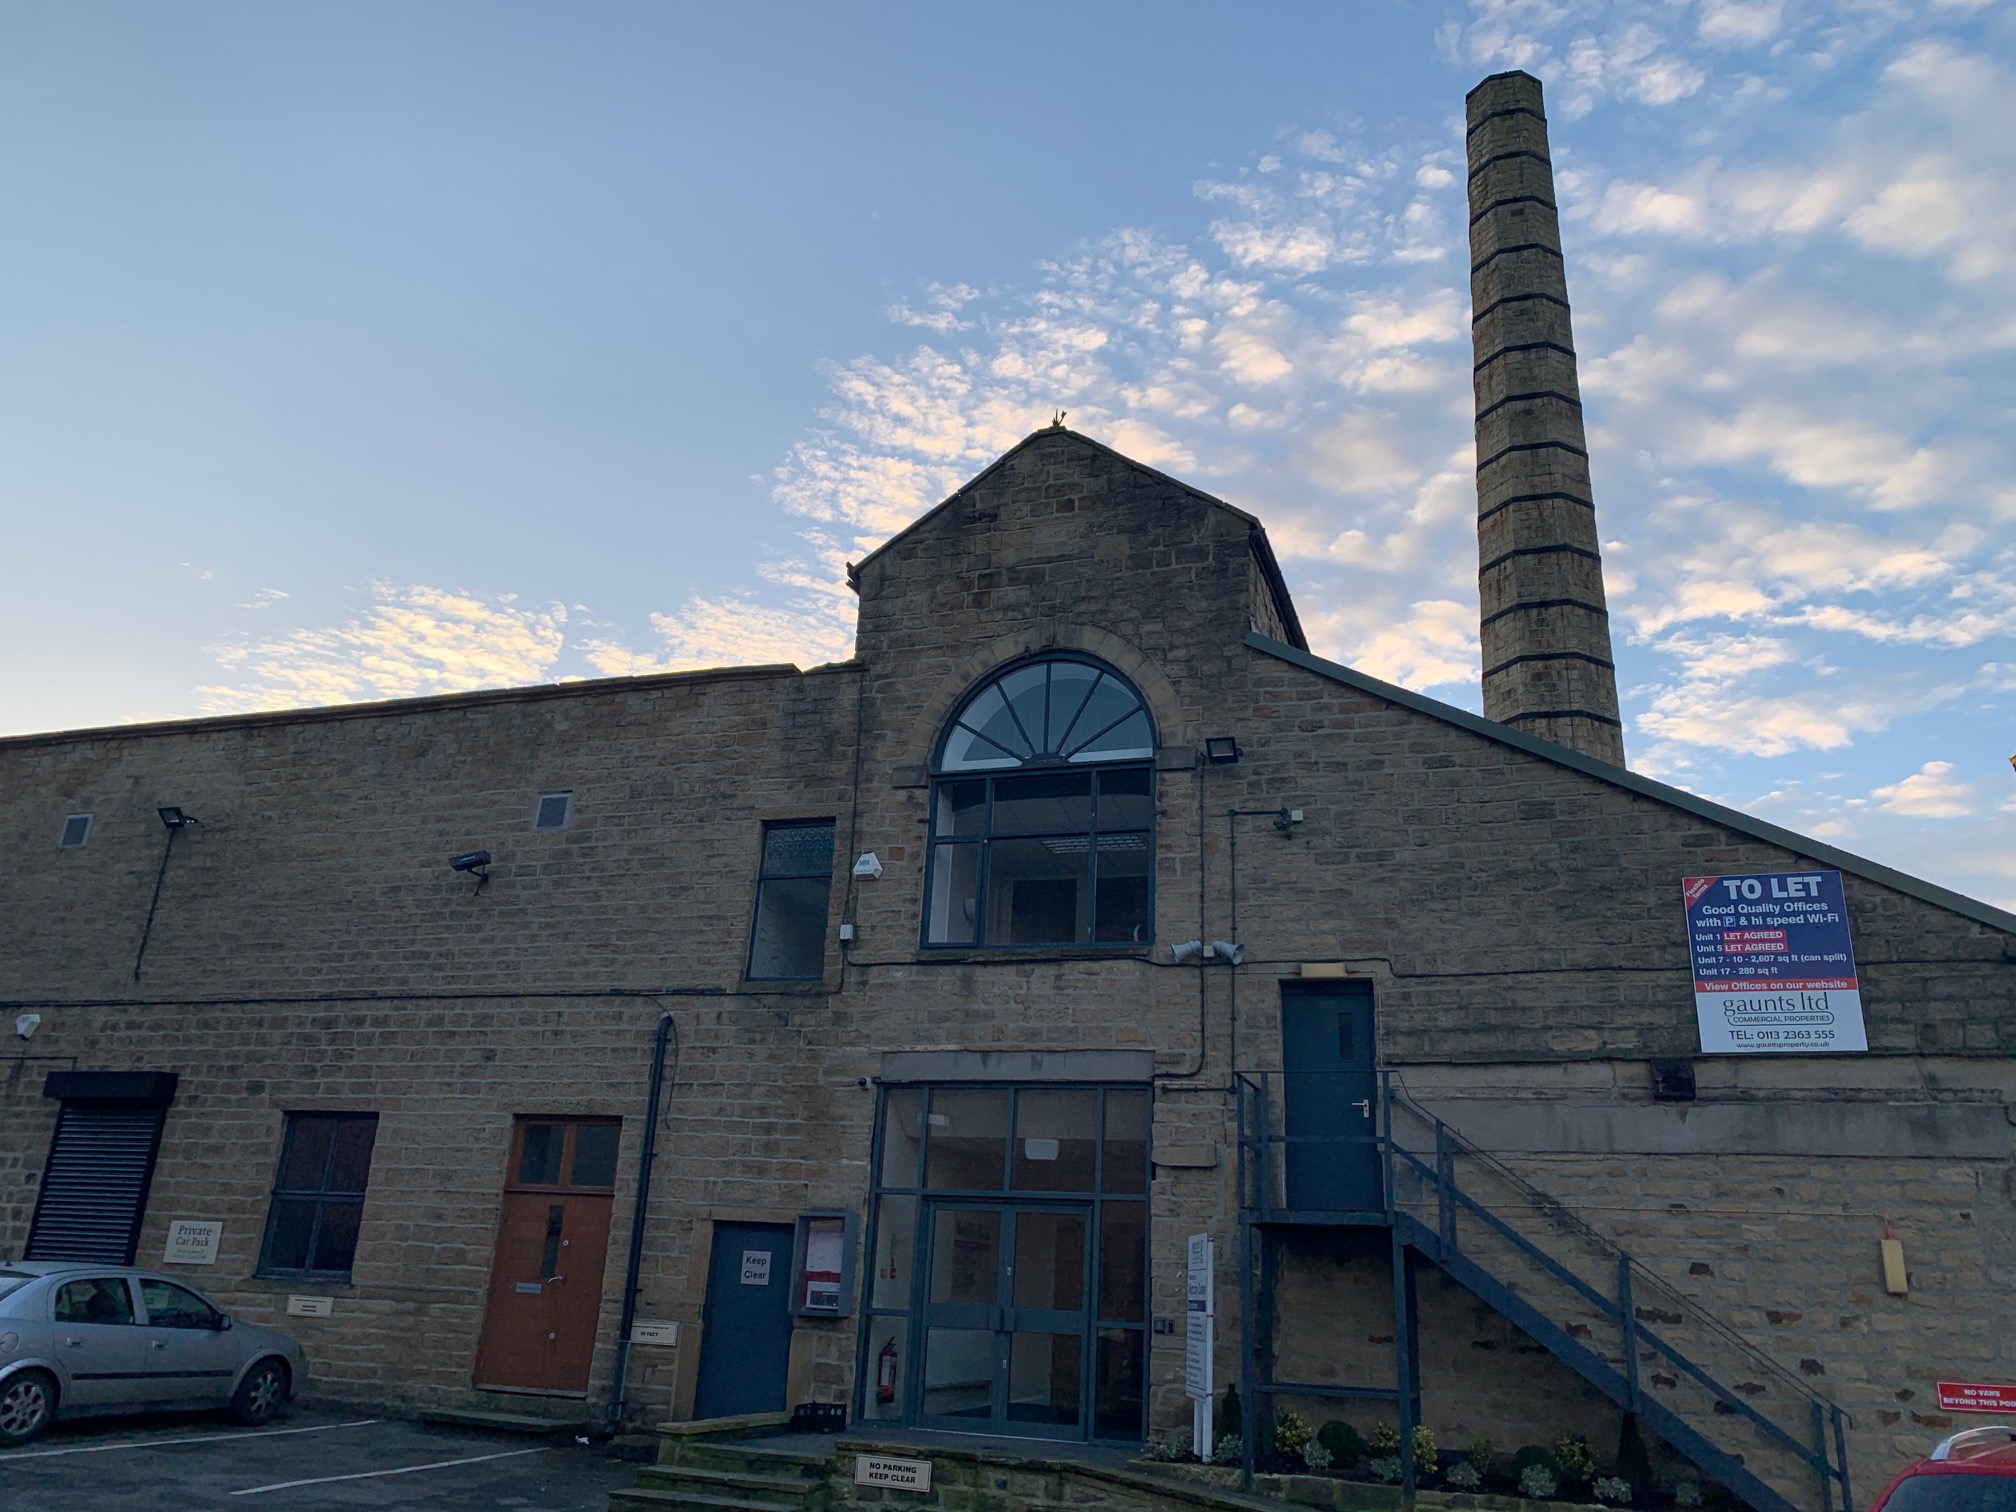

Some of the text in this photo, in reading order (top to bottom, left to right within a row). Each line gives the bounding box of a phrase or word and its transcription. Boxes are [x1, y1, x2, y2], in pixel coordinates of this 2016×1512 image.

[1685, 878, 1705, 898] Flexible
[1692, 884, 1708, 899] Terms
[1723, 876, 1822, 900] TO LET
[1702, 902, 1829, 915] Good Quality Offices
[1696, 918, 1722, 927] with
[1739, 917, 1748, 926] &
[1751, 916, 1763, 925] hi
[1766, 914, 1805, 927] speed
[1807, 913, 1839, 924] Wi-Fi
[1695, 933, 1714, 941] Unit
[1724, 932, 1741, 940] LET
[1743, 931, 1783, 939] AGREED
[1697, 945, 1716, 953] Unit
[1725, 944, 1742, 952] LET
[1745, 943, 1784, 951] AGREED
[1698, 956, 1717, 964] Unit
[1718, 956, 1723, 964] 7
[1733, 955, 1743, 963] 10
[1750, 955, 1775, 964] 2,607
[1800, 954, 1821, 962] (can
[1823, 953, 1847, 962] split)
[1700, 968, 1719, 976] Unit
[1738, 967, 1755, 975] 280
[1771, 966, 1778, 974] ft
[1705, 982, 1729, 990] View
[1731, 982, 1767, 990] Offices
[1806, 980, 1847, 988] website
[1723, 992, 1829, 1017] gaunts ltd
[1729, 1030, 1835, 1040] TEL: 0113 2363 555
[1736, 1041, 1830, 1049] www.gauntsproperty.co.uk
[178, 1224, 213, 1236] Private
[176, 1236, 209, 1247] Car Park
[746, 1256, 767, 1267] Keep
[744, 1270, 766, 1279] Clear
[1943, 1397, 1977, 1405] BEYOND
[1978, 1399, 1998, 1407] THIS
[869, 1462, 917, 1474] NO PARKING
[869, 1472, 916, 1484] KEEP CLEAR
